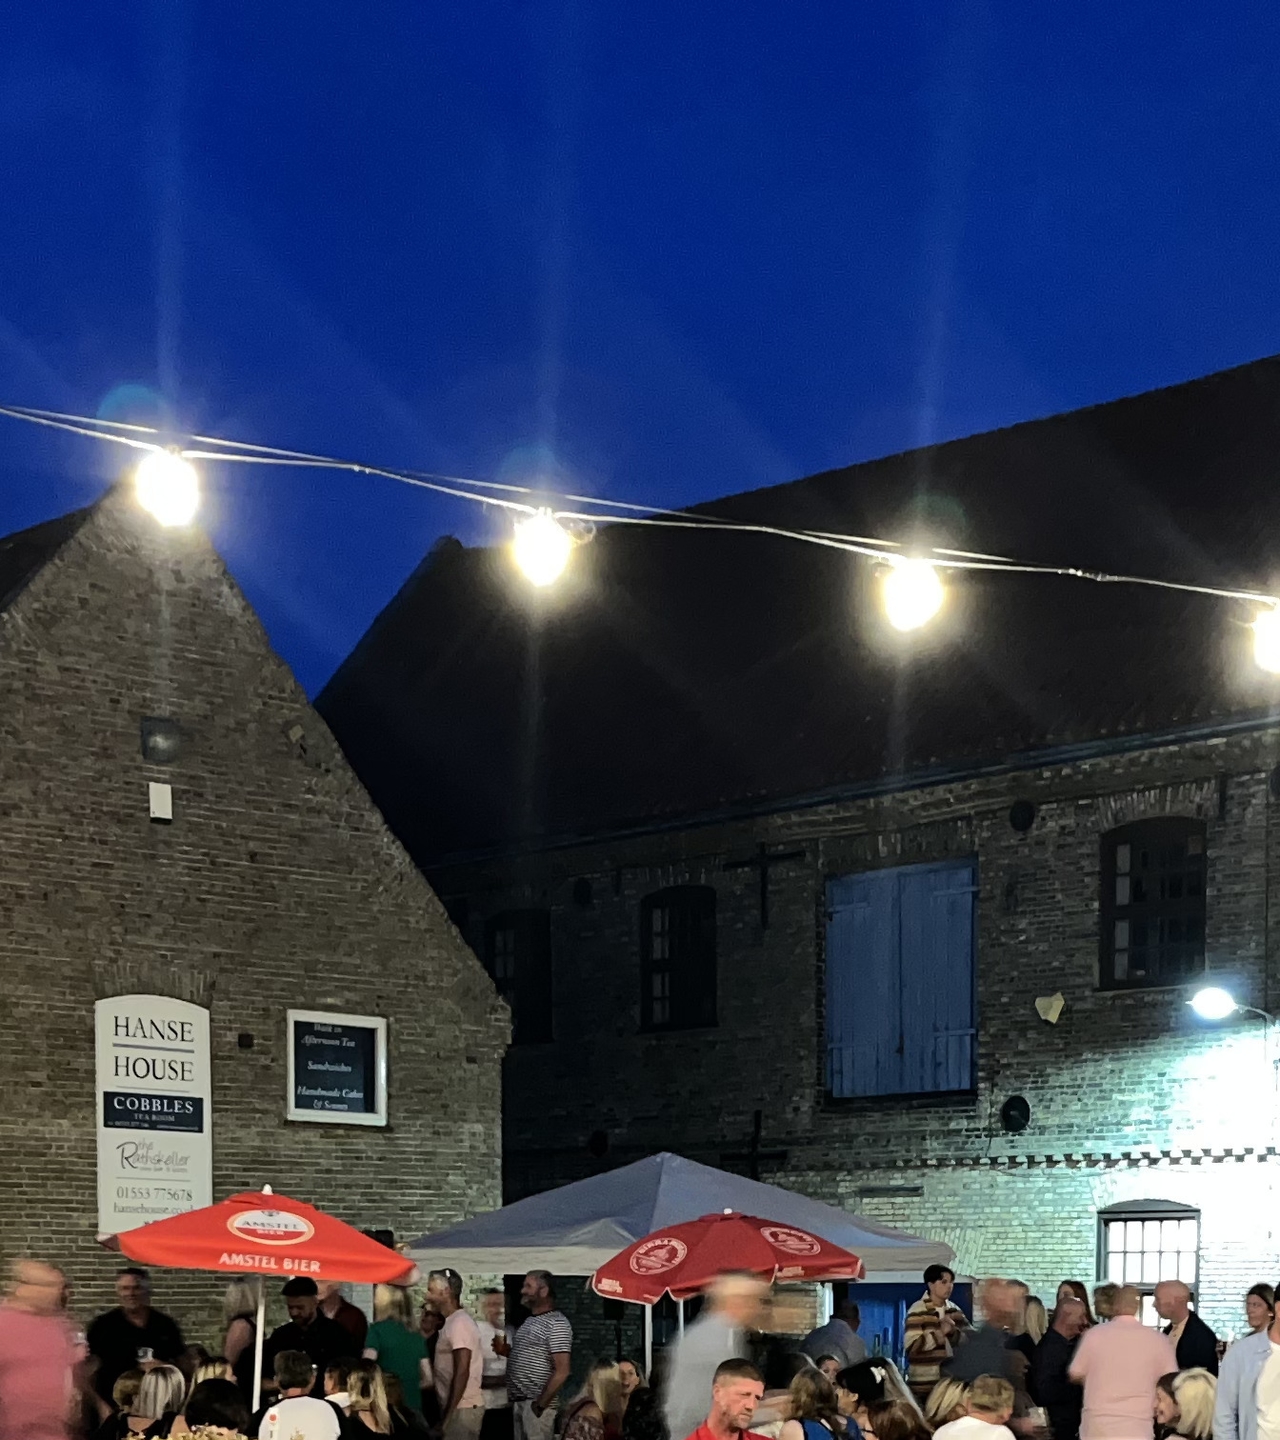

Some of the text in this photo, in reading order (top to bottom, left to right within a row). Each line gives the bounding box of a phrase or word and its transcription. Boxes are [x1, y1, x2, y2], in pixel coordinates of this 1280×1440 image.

[113, 1015, 195, 1043] HANSE
[113, 1055, 195, 1082] HOUSE
[113, 1096, 194, 1114] COBBLES
[116, 1185, 194, 1202] 01553 775678
[241, 1220, 301, 1230] AMSTEL
[218, 1252, 321, 1273] AMSTEL BIER
